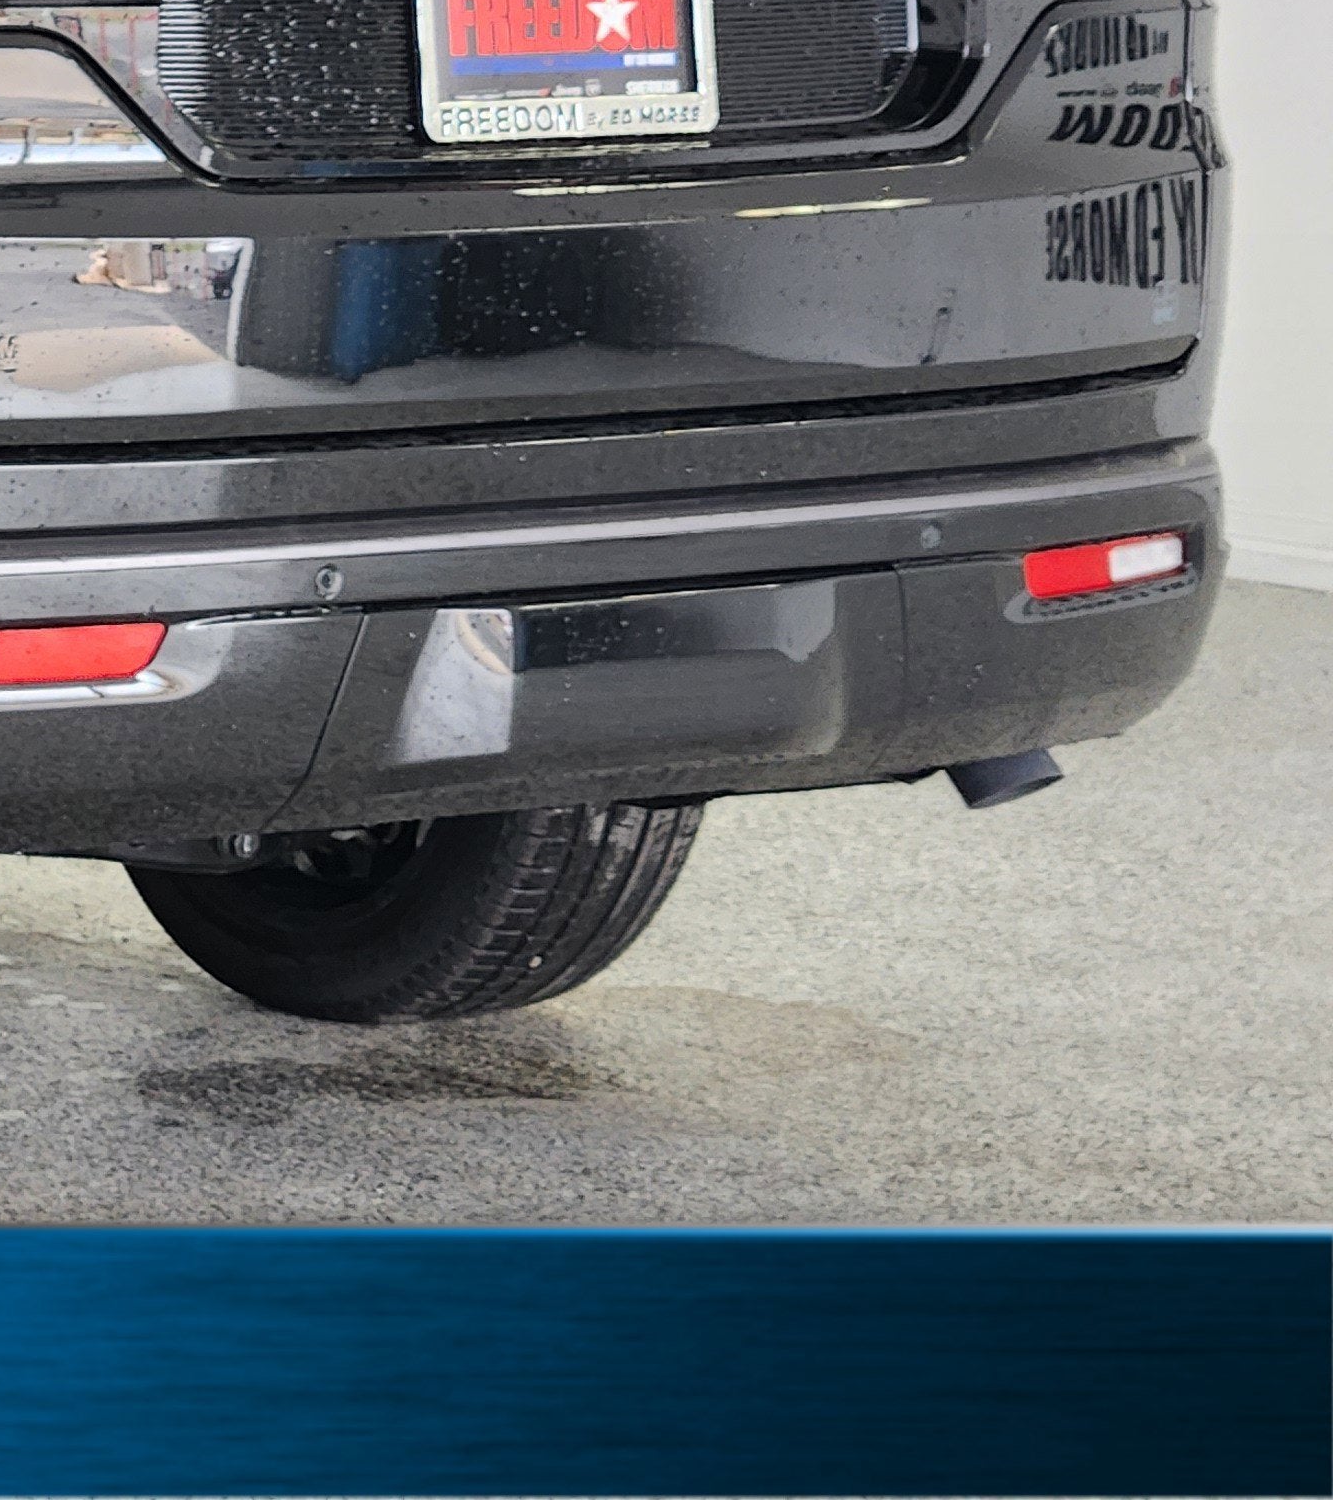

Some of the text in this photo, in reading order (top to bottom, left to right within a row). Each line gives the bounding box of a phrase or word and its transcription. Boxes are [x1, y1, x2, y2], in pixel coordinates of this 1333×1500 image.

[440, 104, 583, 138] FREEDOM
[609, 108, 633, 127] ED
[638, 104, 701, 125] MORSE
